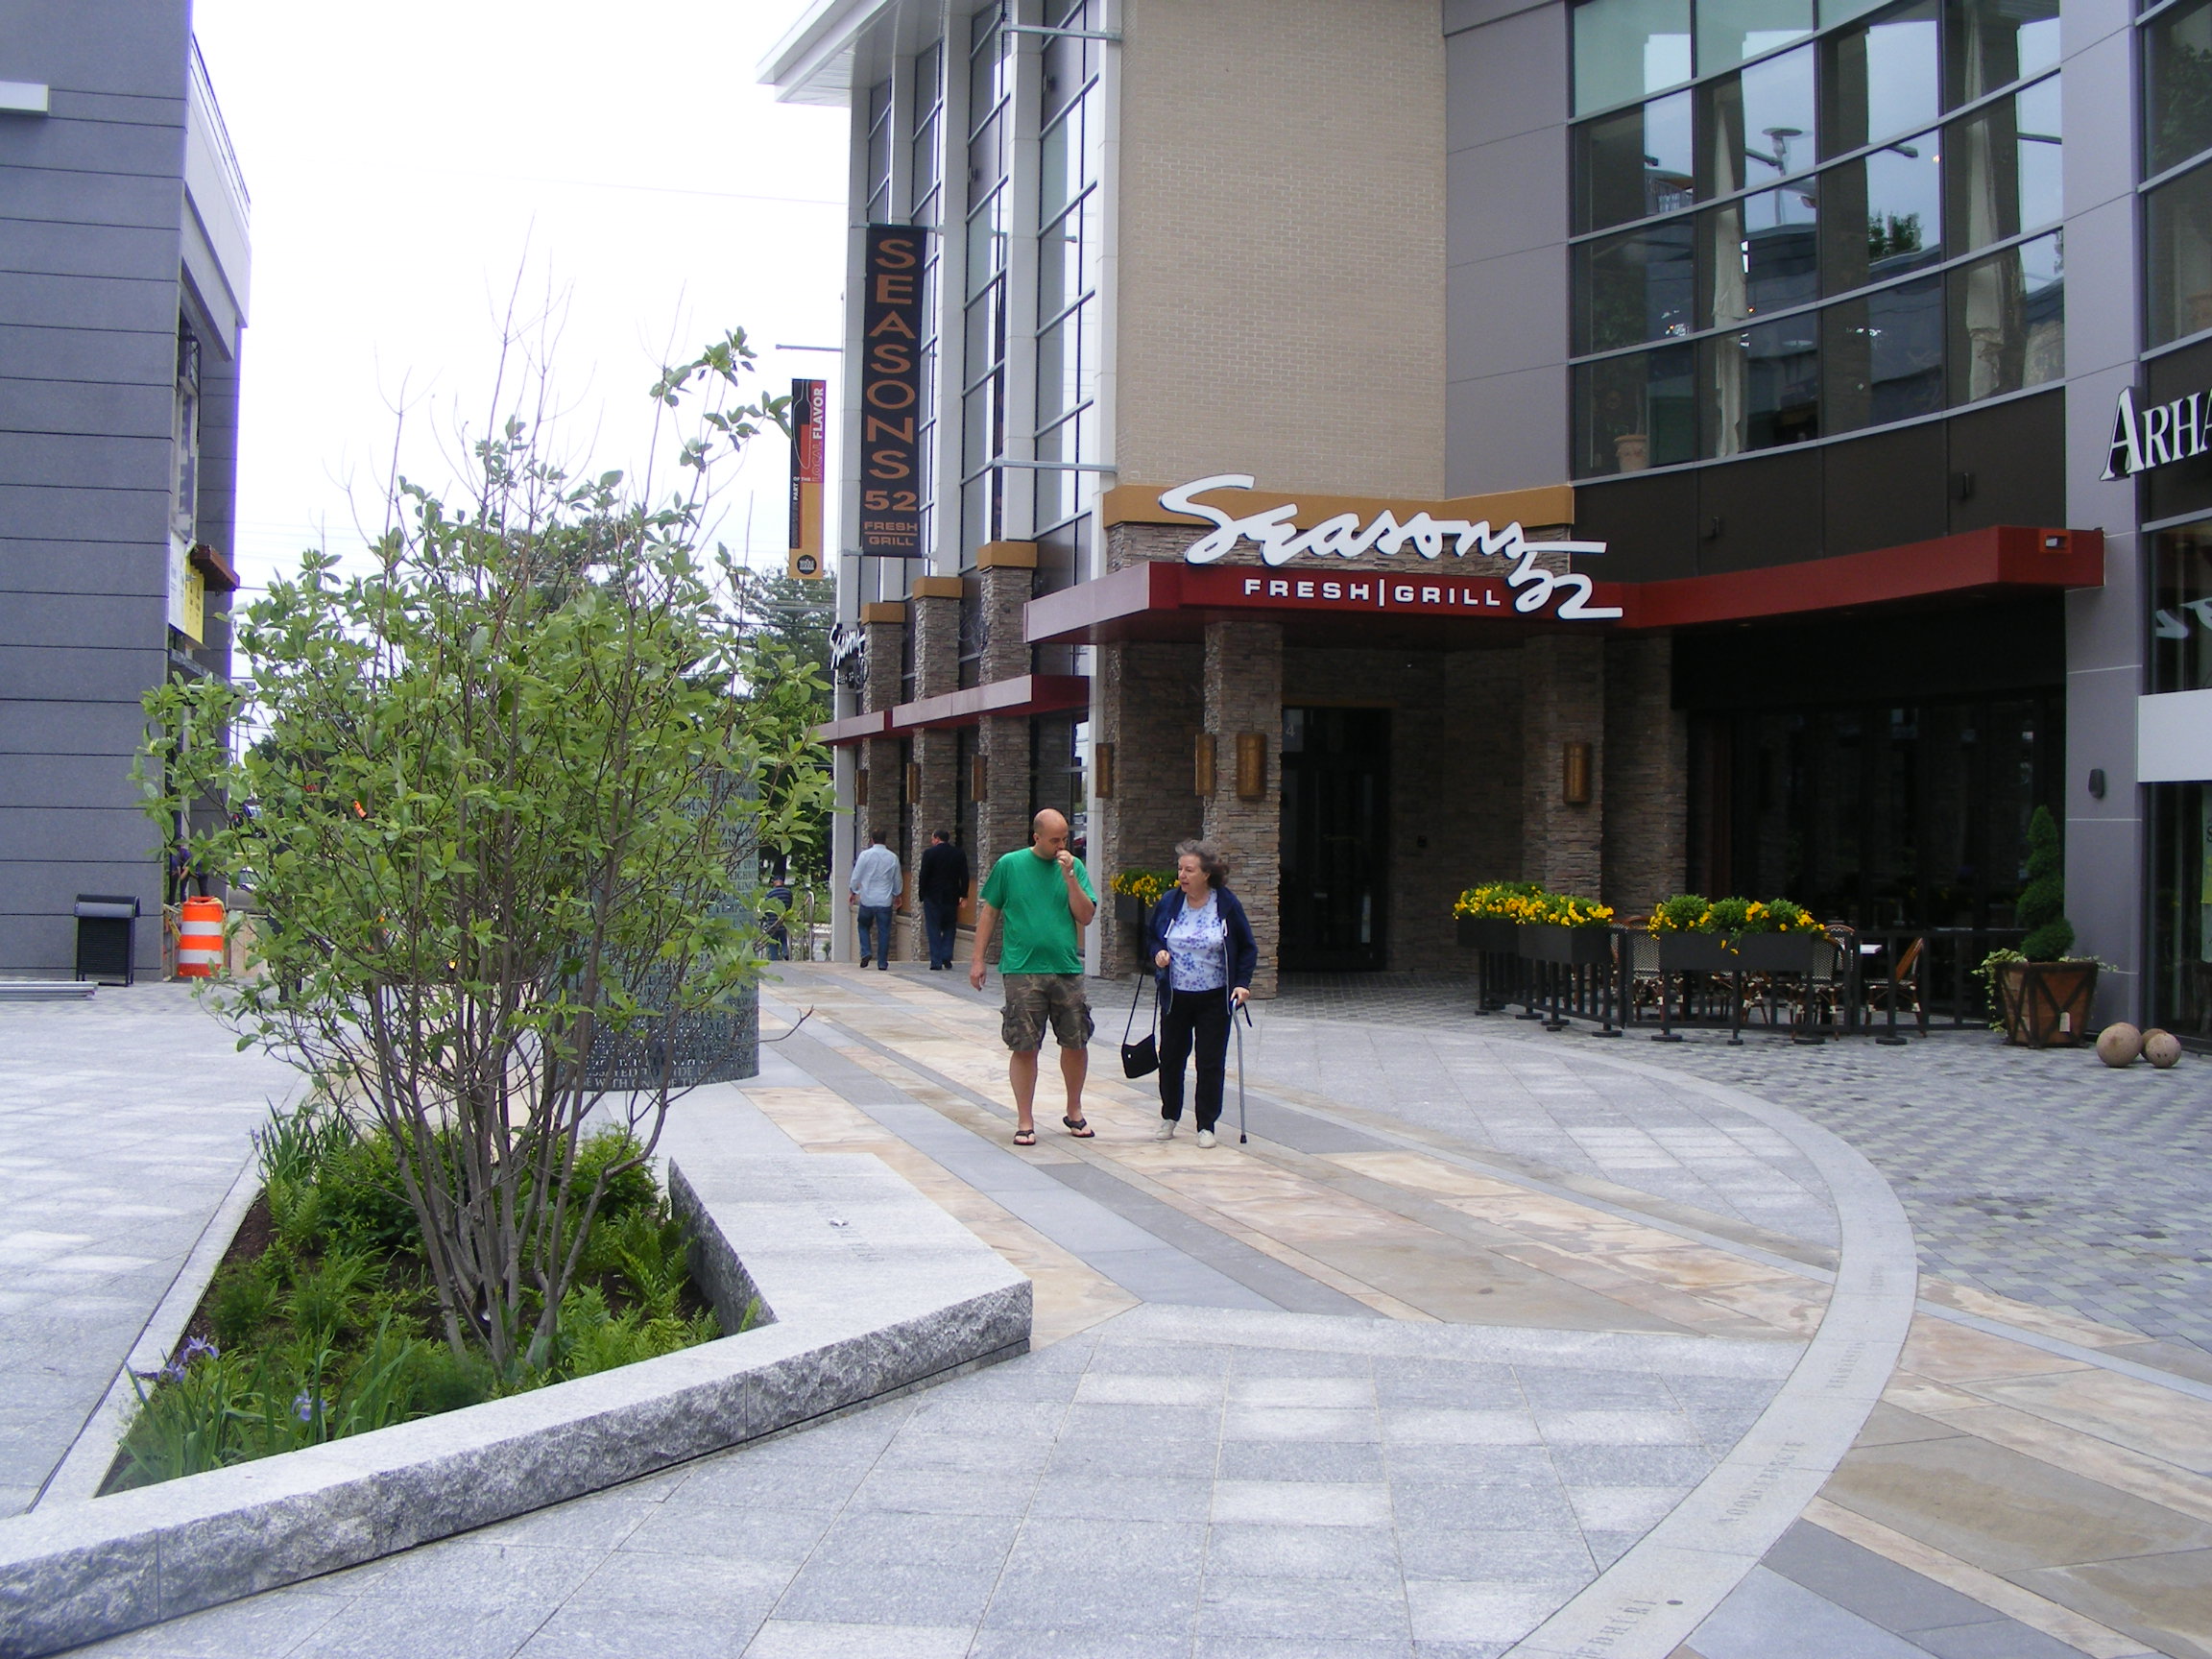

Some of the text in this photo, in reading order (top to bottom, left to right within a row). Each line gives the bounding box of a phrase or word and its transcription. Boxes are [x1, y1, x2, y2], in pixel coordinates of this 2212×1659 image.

[866, 237, 917, 479] SEASONS
[812, 387, 824, 440] FLAVOR
[864, 490, 918, 512] 52
[864, 520, 918, 533] FRESH
[868, 535, 915, 546] GRILL
[1158, 473, 1624, 620] Seasons 52
[1243, 578, 1502, 607] FRESH GRILL
